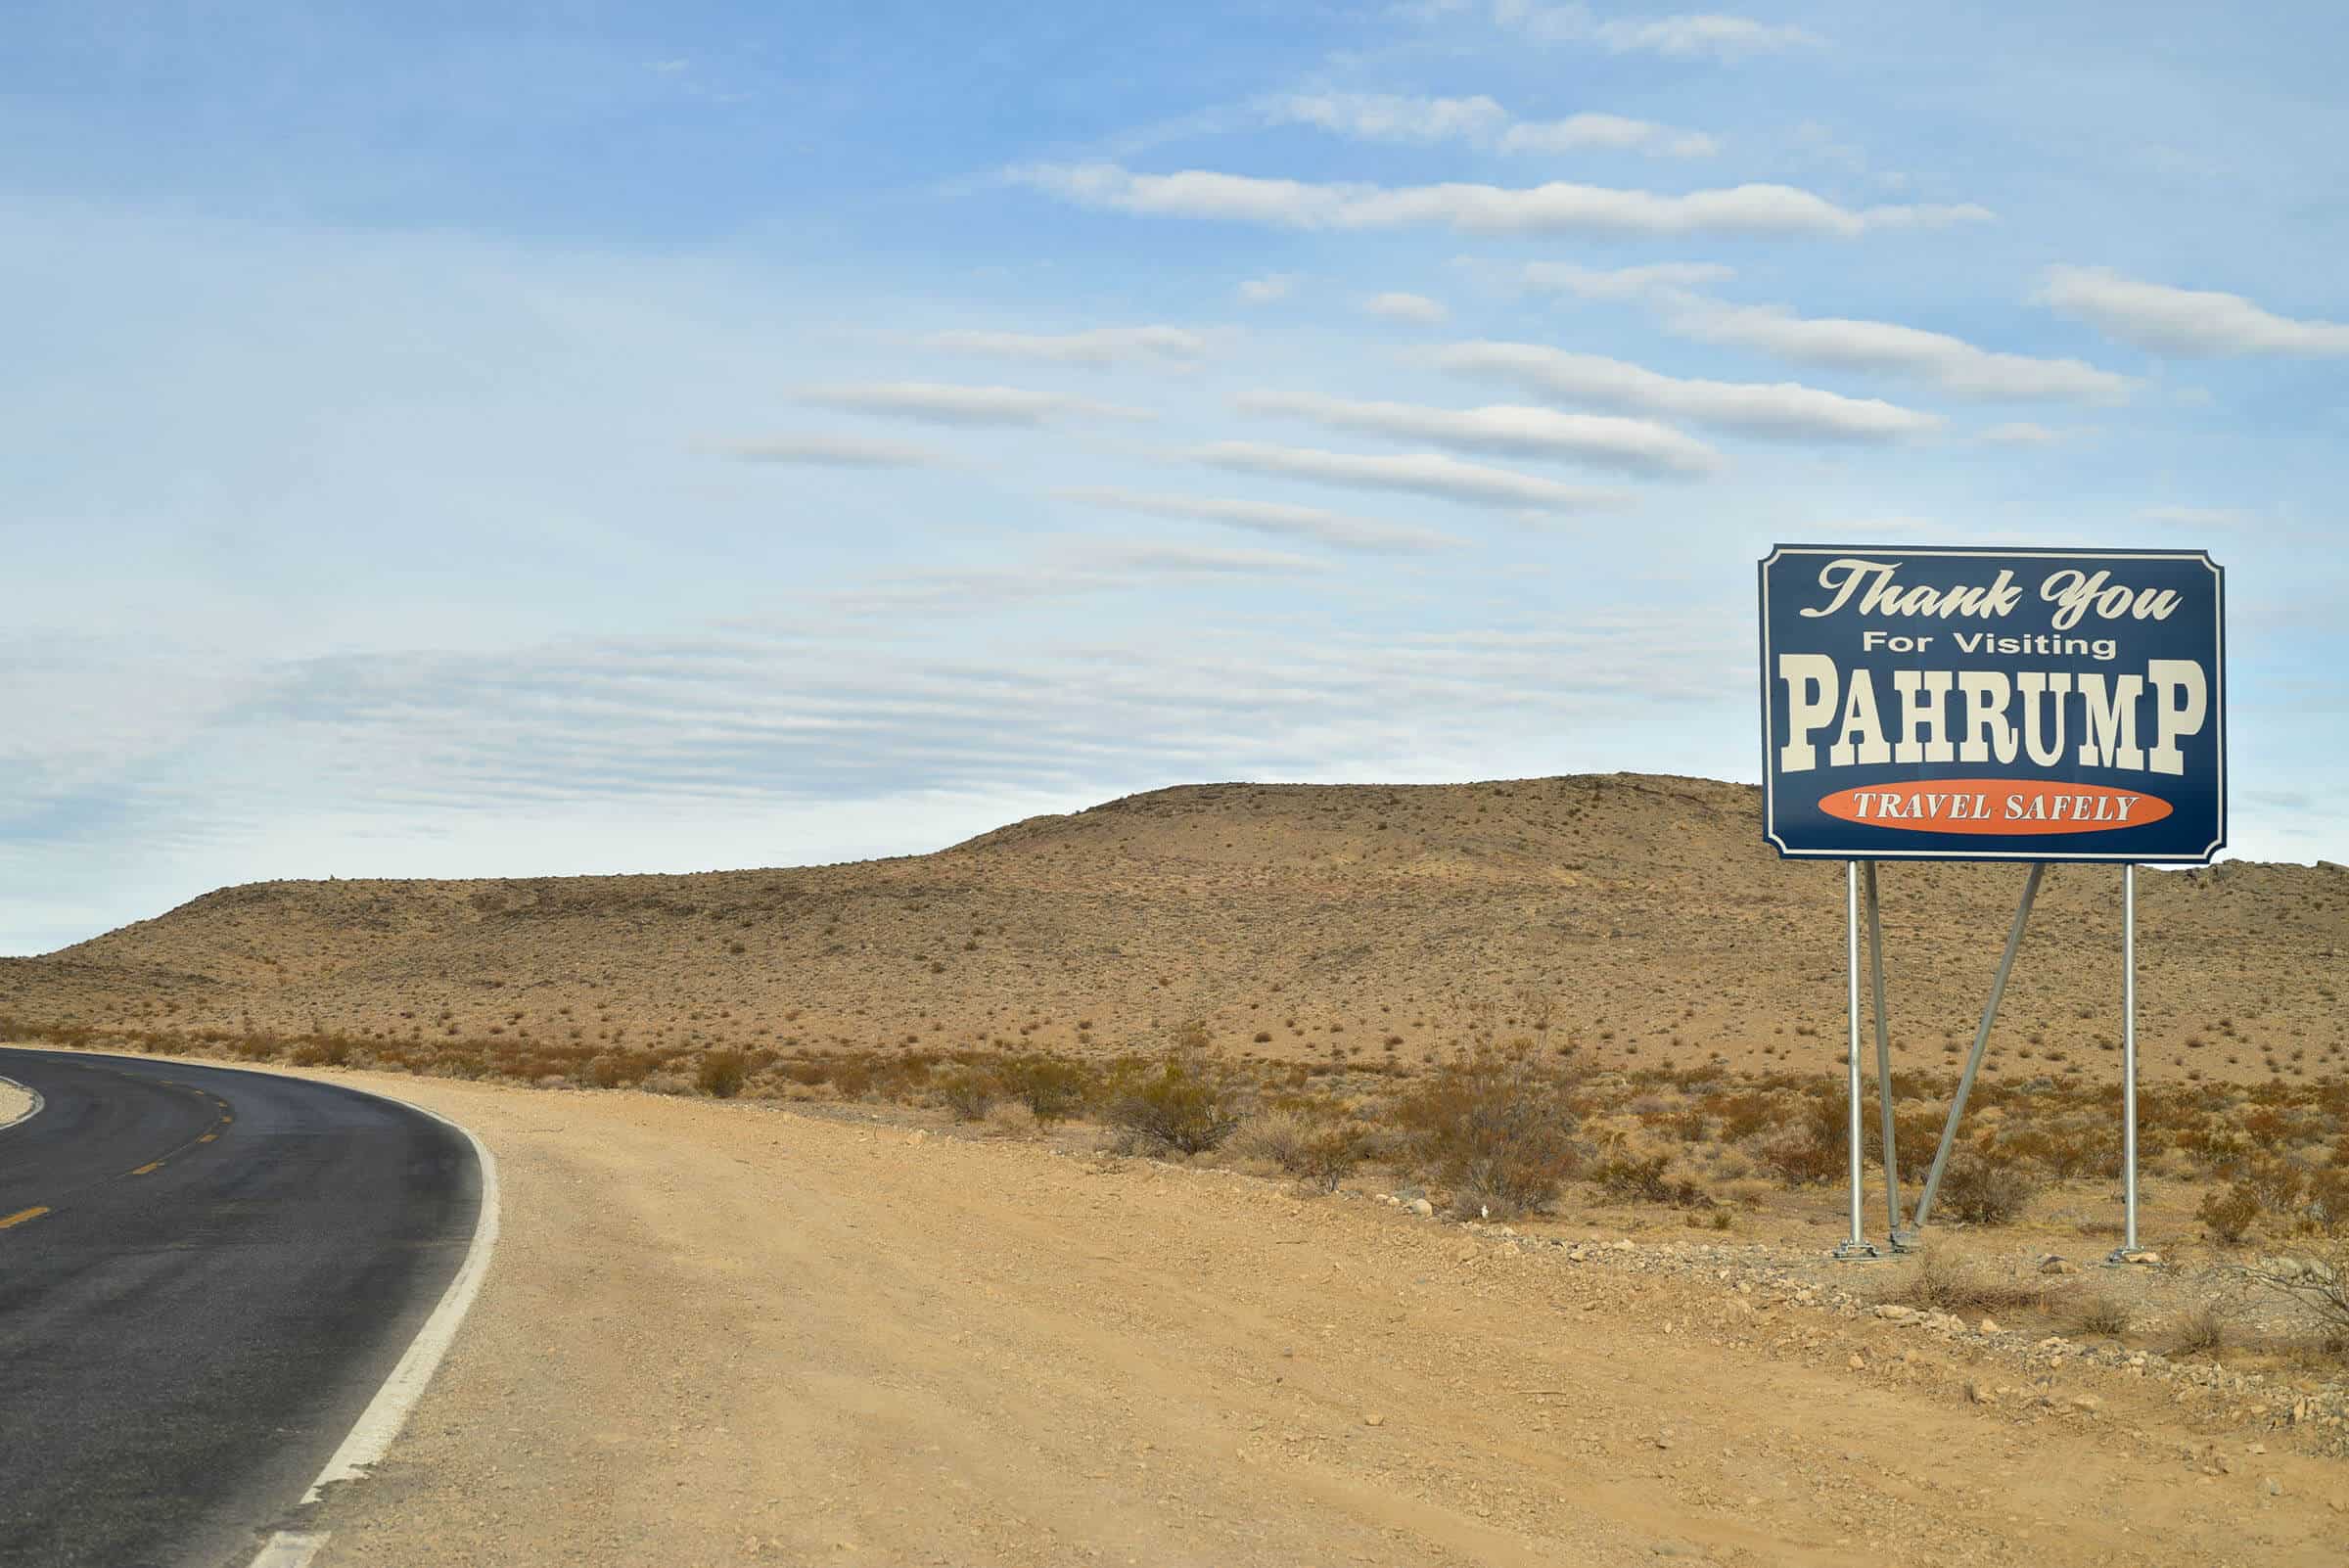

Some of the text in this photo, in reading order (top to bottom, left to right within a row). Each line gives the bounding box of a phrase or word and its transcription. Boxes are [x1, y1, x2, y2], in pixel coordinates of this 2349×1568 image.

[1799, 558, 2183, 630] Thank You
[1863, 630, 2116, 661] For Visiting
[1778, 653, 2207, 776] PAHRUMP
[1853, 792, 2141, 821] TRAVEL SAFELY
